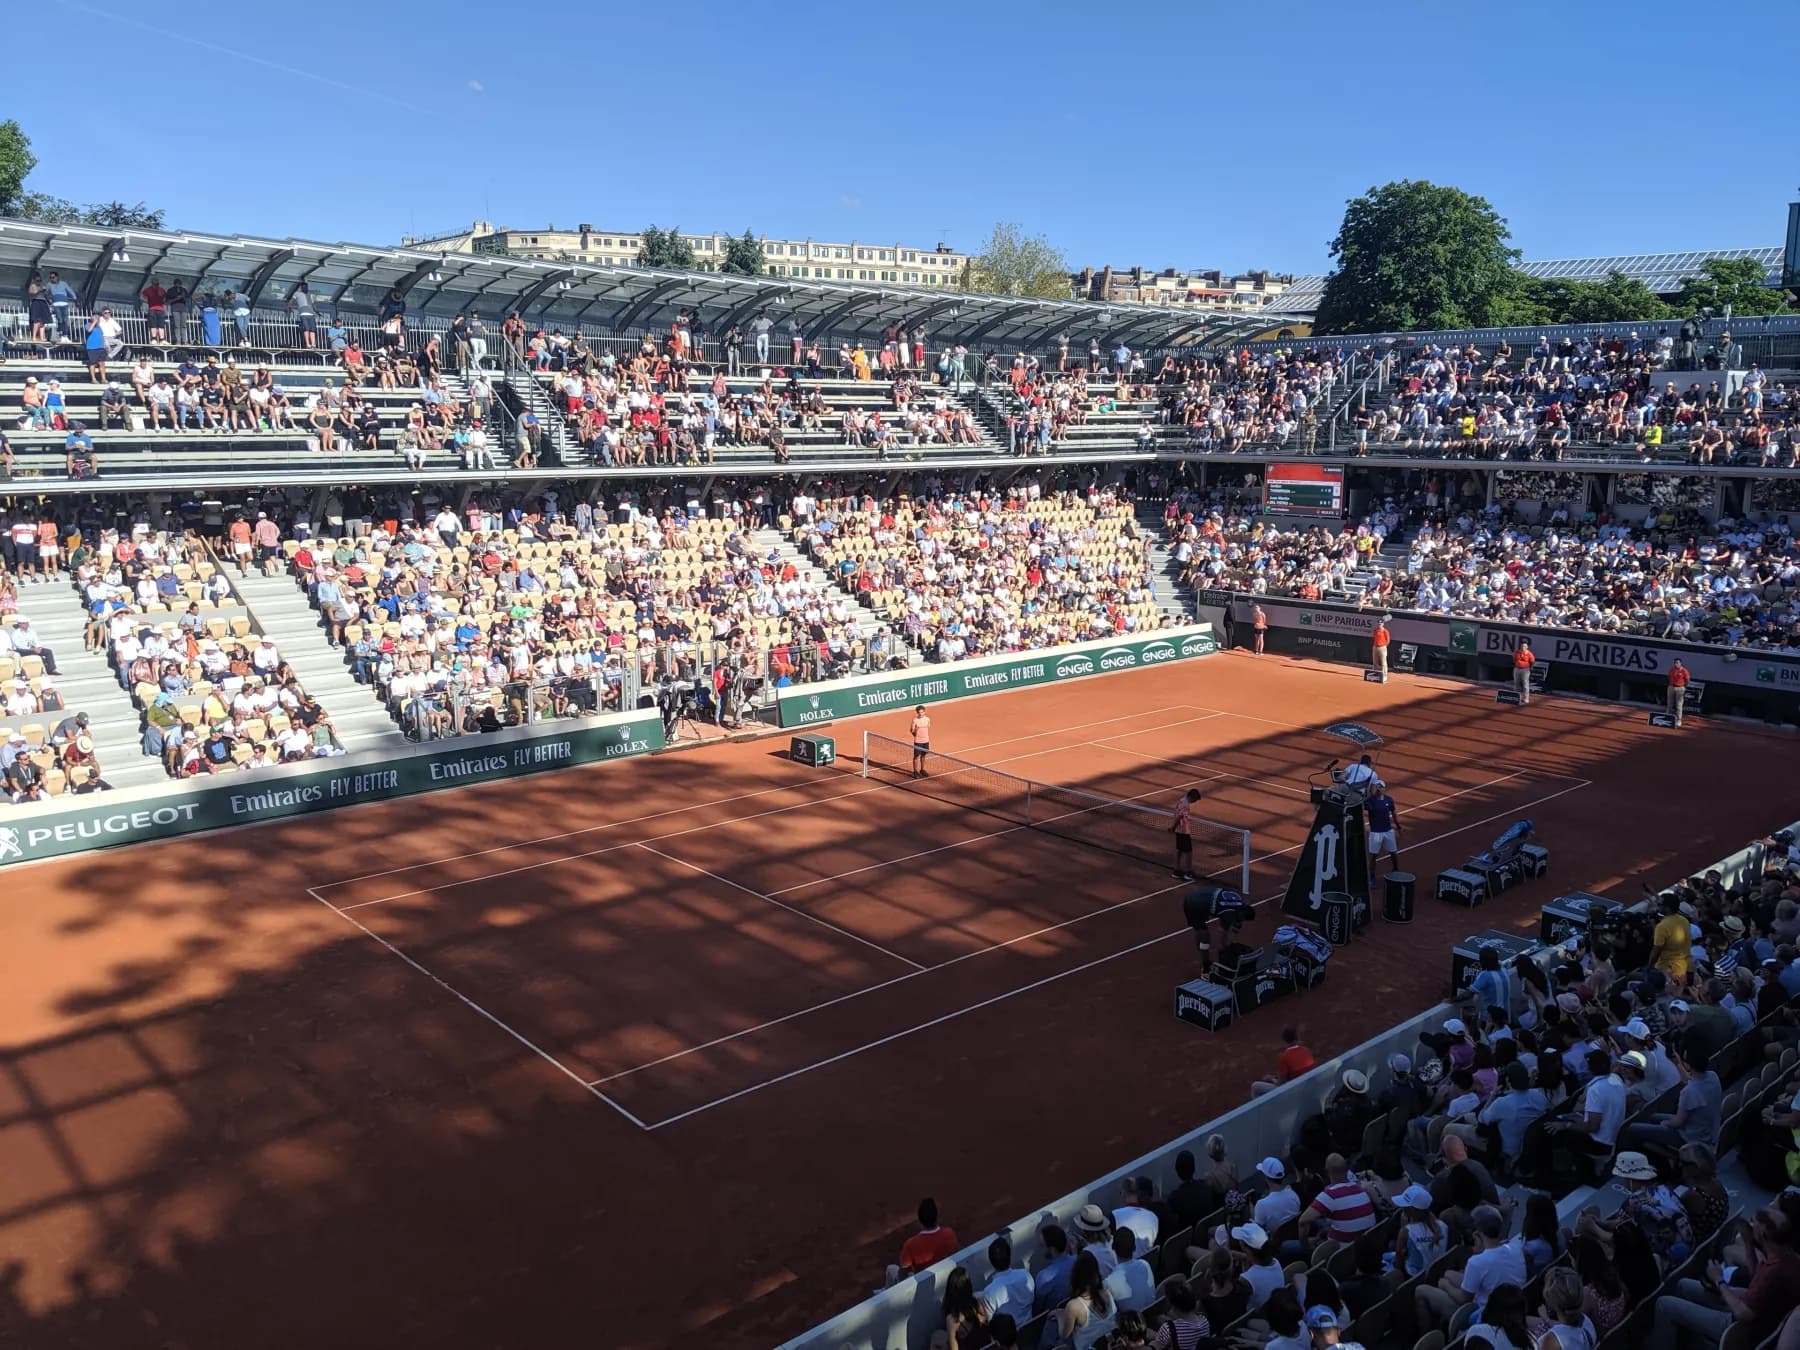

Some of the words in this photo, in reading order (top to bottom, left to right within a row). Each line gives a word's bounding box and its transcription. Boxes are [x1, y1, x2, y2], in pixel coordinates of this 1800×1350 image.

[1314, 613, 1333, 625] BNP
[1334, 616, 1373, 629] PARIBAS
[1555, 639, 1659, 671] PARIBAS
[964, 671, 1009, 689] Emirates
[1011, 668, 1022, 681] FLY
[1022, 663, 1045, 679] BETTER
[857, 688, 908, 708] Emirates
[910, 684, 923, 698] FLY
[923, 679, 948, 697] BETTER
[800, 708, 835, 722] ROLEX
[430, 752, 508, 781] Emirates
[514, 747, 533, 767] FLY
[534, 741, 572, 762] BETTER
[605, 739, 649, 756] ROLEX
[231, 784, 323, 815] Emirates
[331, 777, 351, 798] FLY
[354, 769, 398, 794] BETTER
[28, 803, 200, 847] PEUGEOT
[1178, 993, 1212, 1019] perrier
